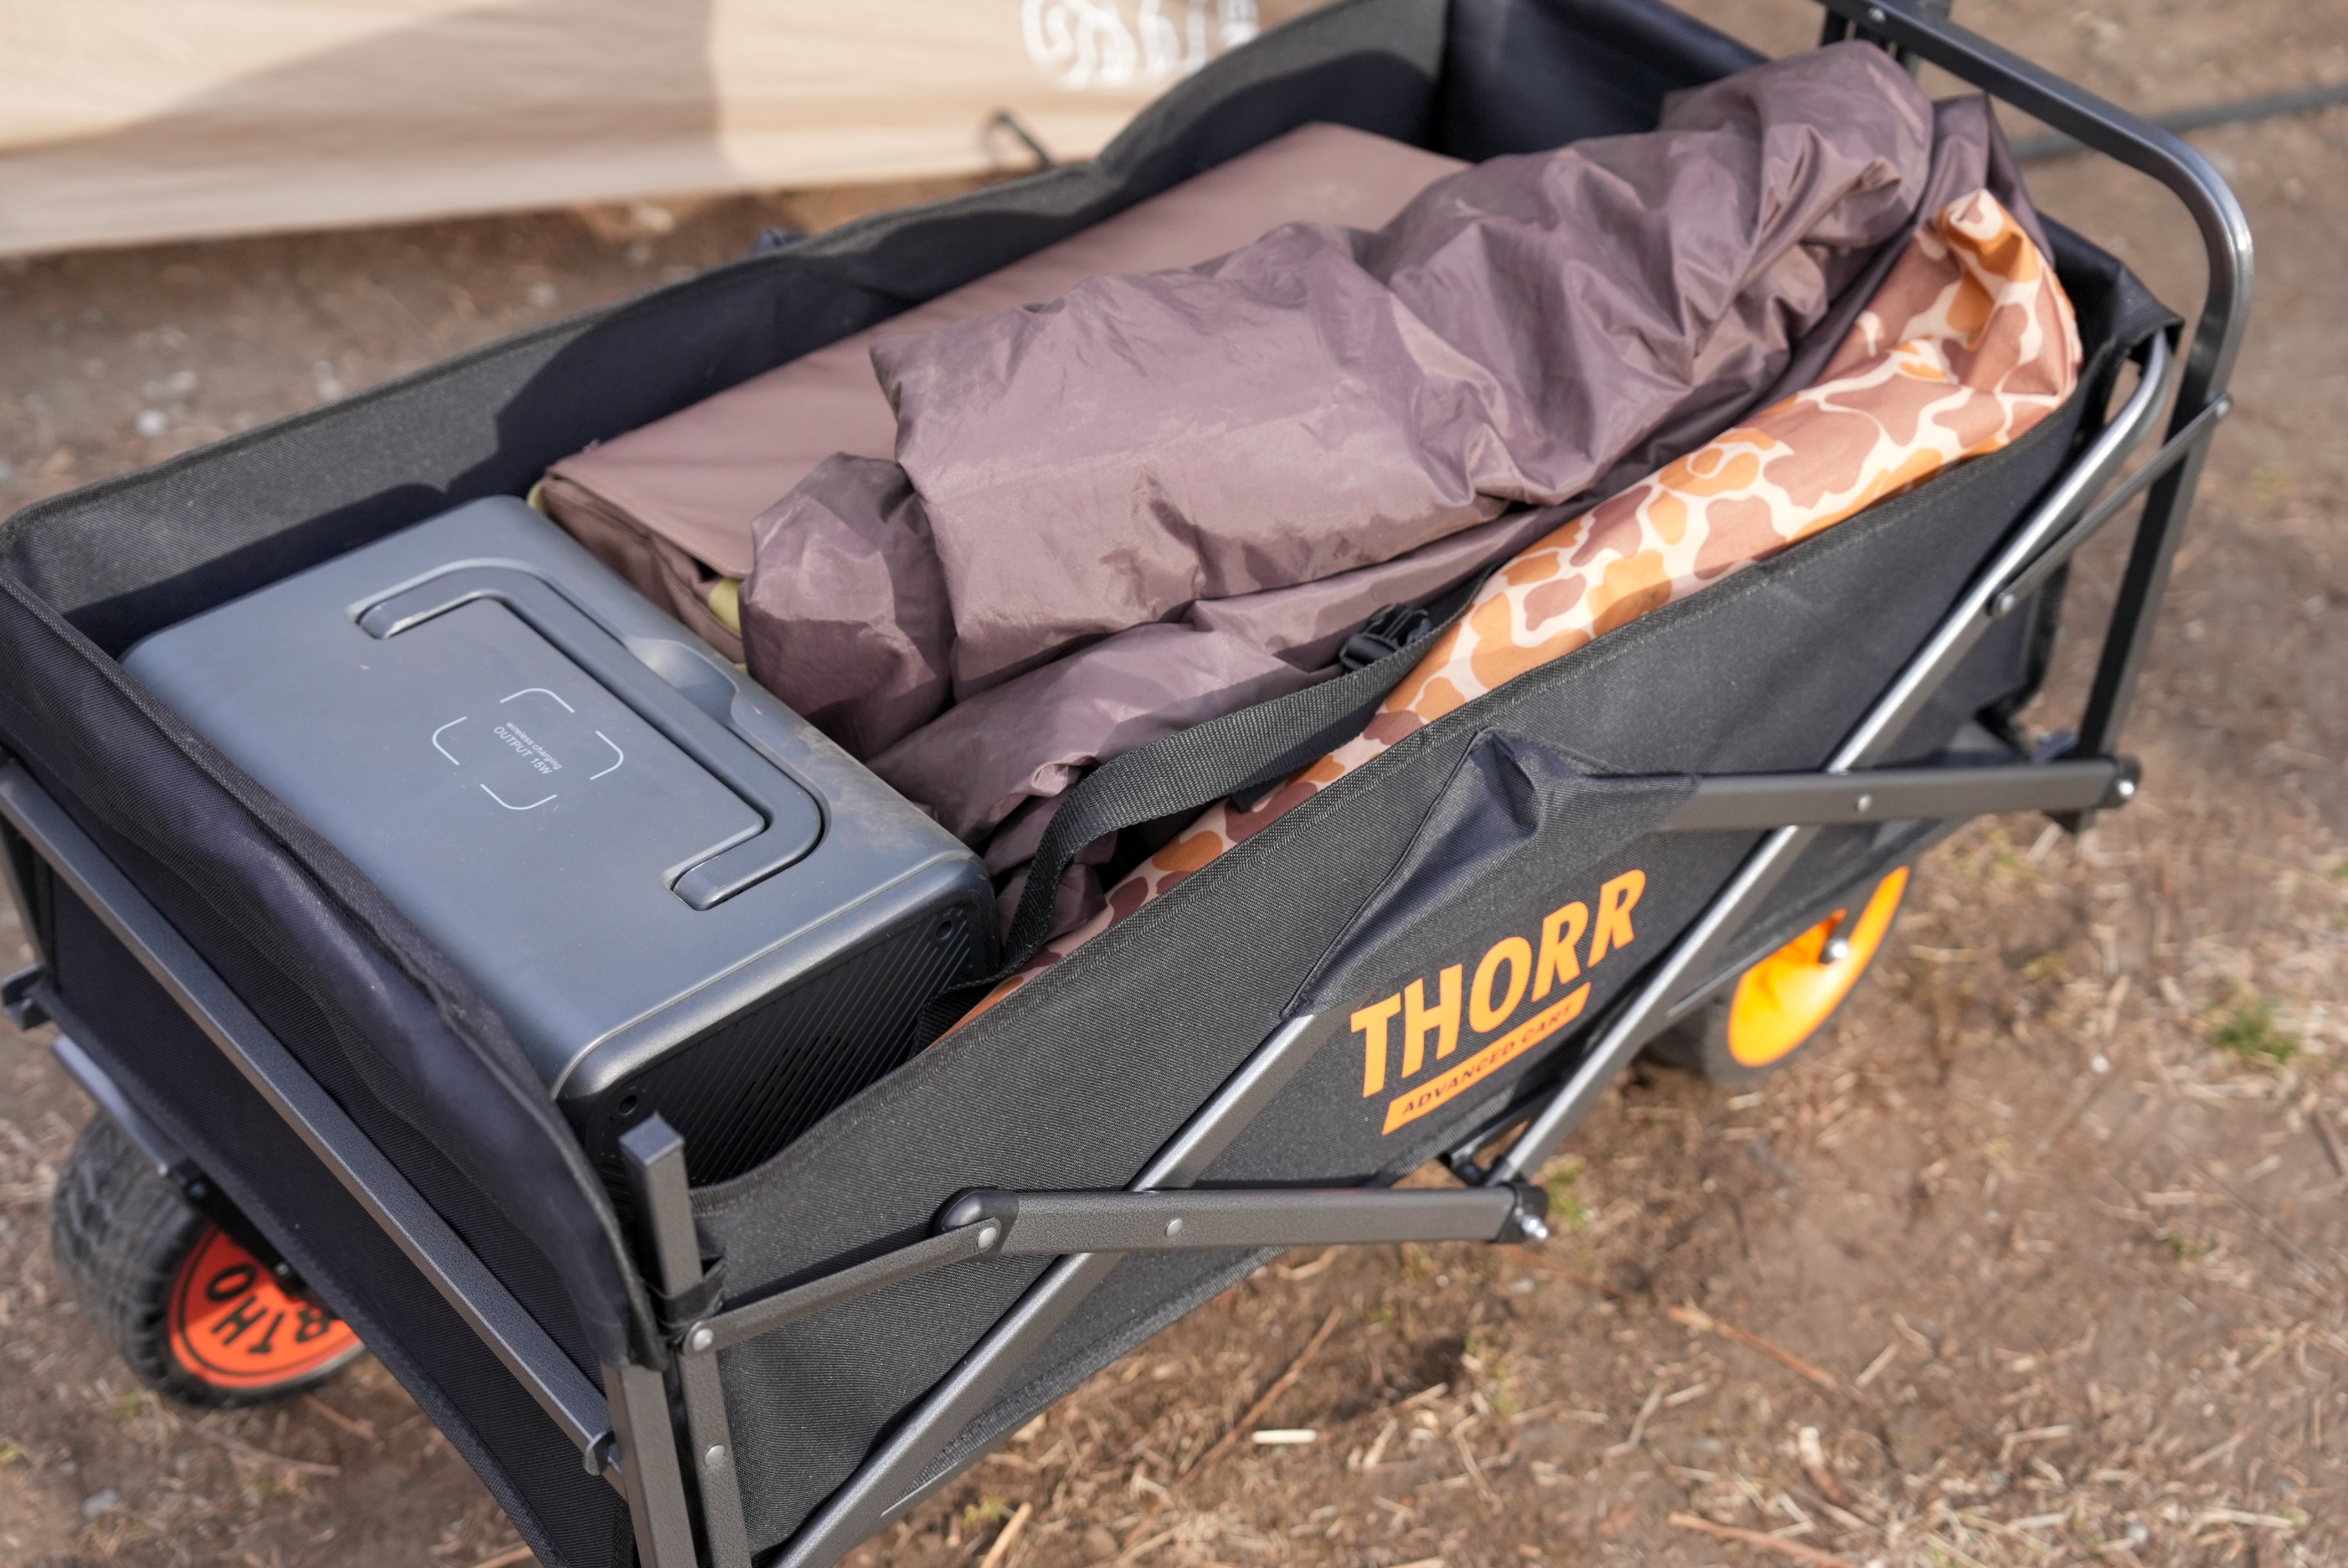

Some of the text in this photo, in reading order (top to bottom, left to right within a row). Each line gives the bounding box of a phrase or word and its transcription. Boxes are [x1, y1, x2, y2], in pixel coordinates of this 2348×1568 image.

[493, 726, 553, 775] OUTPUT 15W
[505, 721, 562, 770] wireless charging
[1350, 869, 1646, 1098] THORR
[1402, 1005, 1573, 1116] ADVANCED CART
